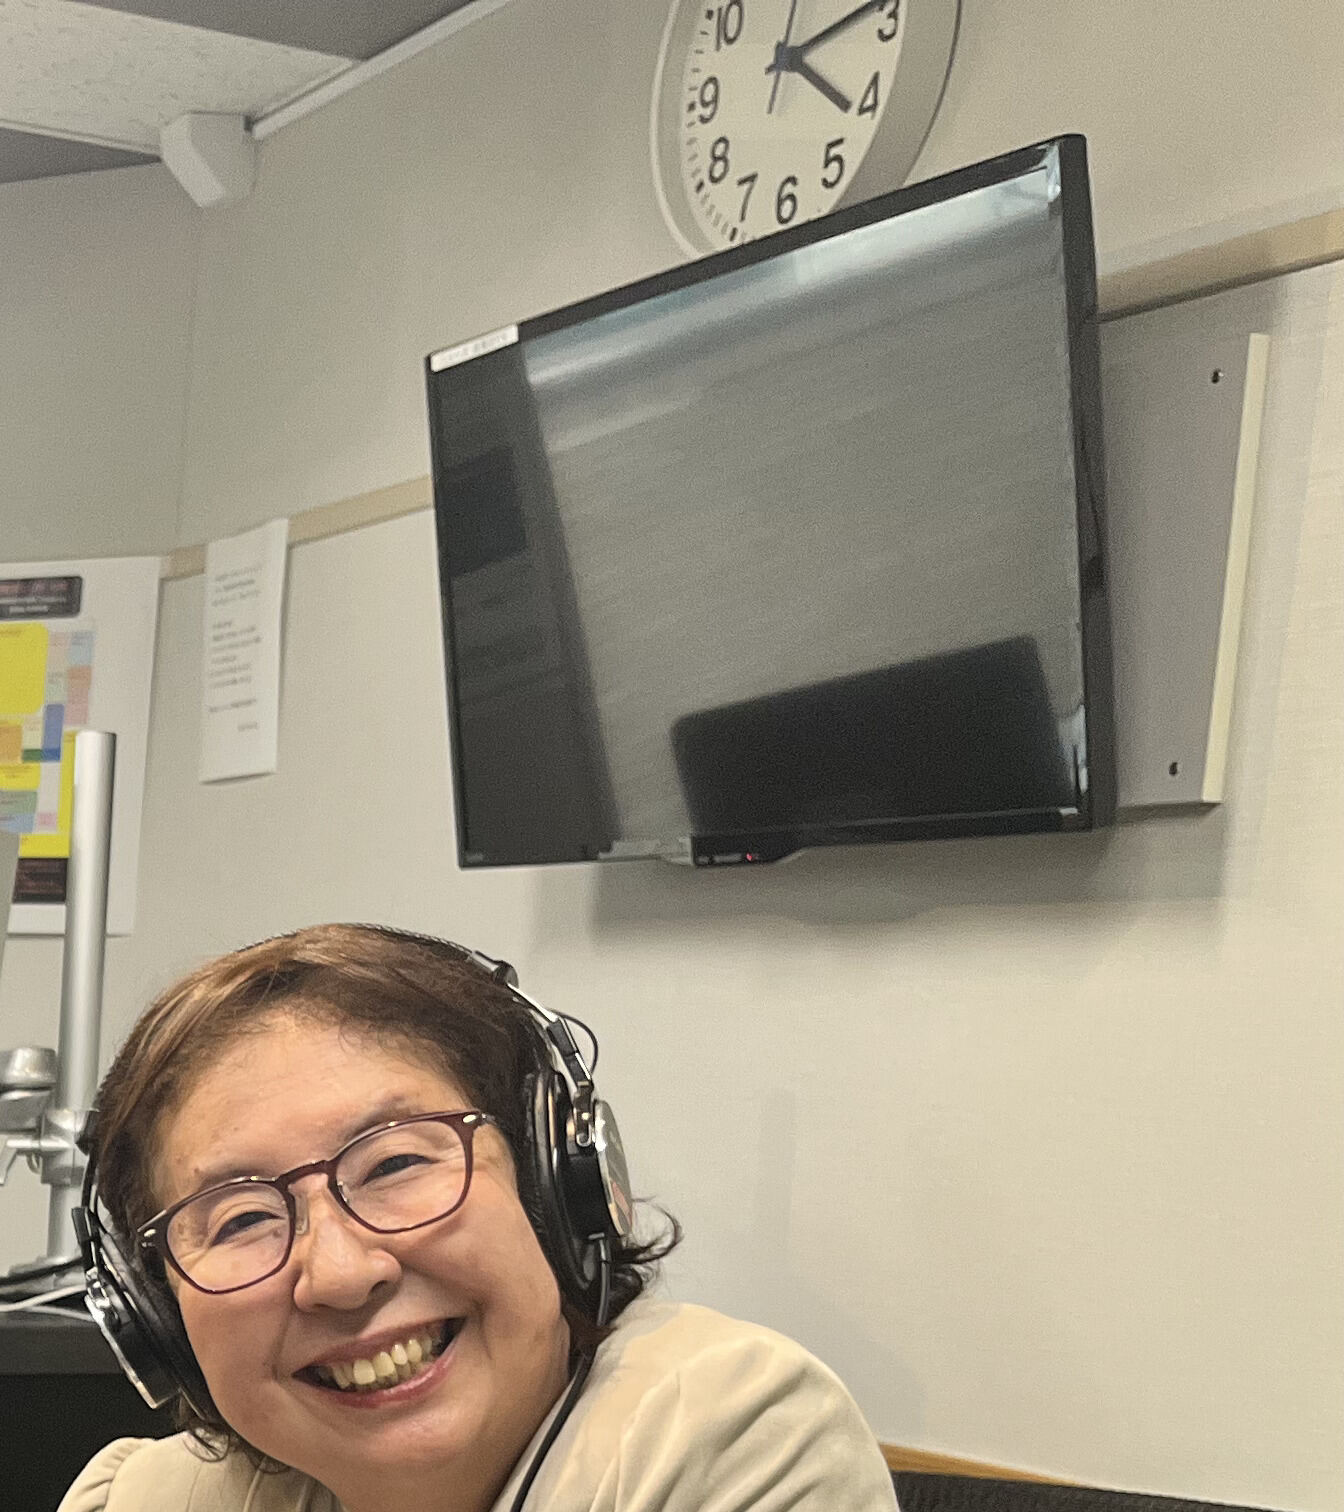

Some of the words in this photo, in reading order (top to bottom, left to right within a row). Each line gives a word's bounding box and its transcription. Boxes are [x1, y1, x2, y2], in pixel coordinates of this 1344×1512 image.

[698, 76, 720, 124] 9
[858, 71, 880, 120] 4
[708, 136, 730, 184] 8
[821, 137, 846, 189] 5
[736, 172, 759, 222] 7
[775, 175, 798, 225] 6
